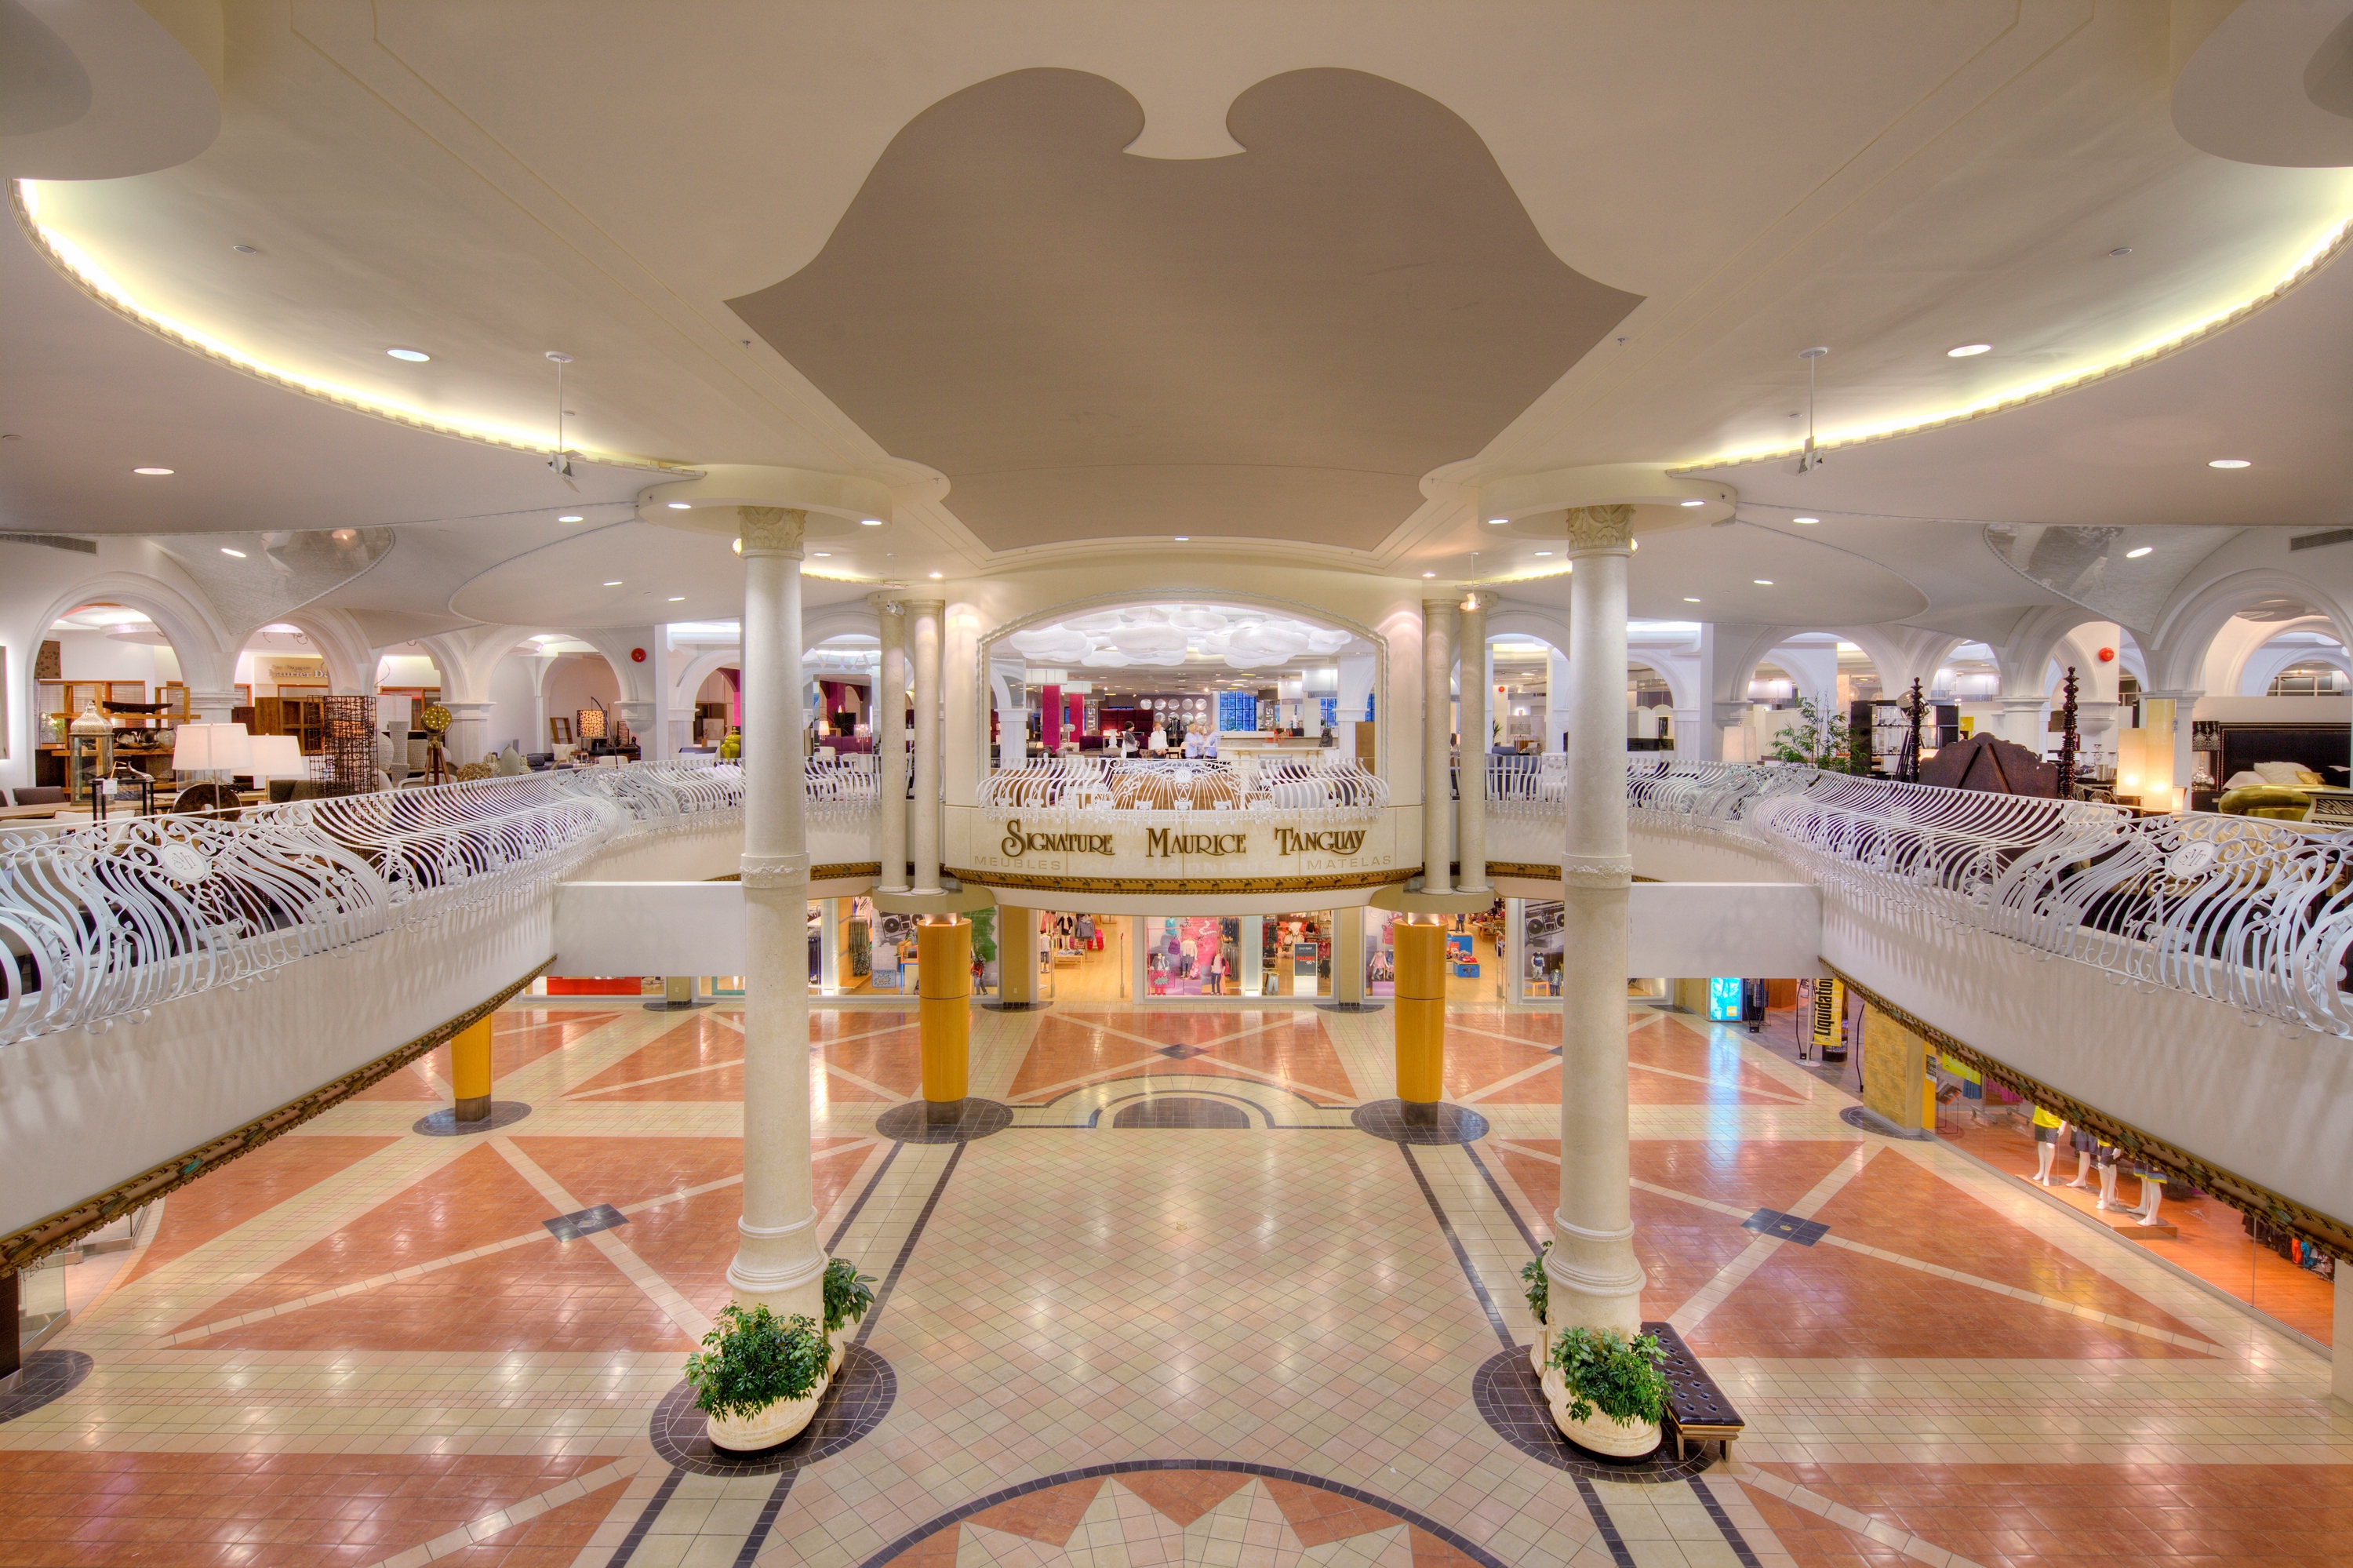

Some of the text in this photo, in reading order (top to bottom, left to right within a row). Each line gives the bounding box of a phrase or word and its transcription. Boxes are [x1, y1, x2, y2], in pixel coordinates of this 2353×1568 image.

[1001, 818, 1367, 858] SIGNATURE MAURICE TANGUAY
[973, 855, 1061, 870] MEUBLES
[1307, 855, 1391, 870] MATELAS
